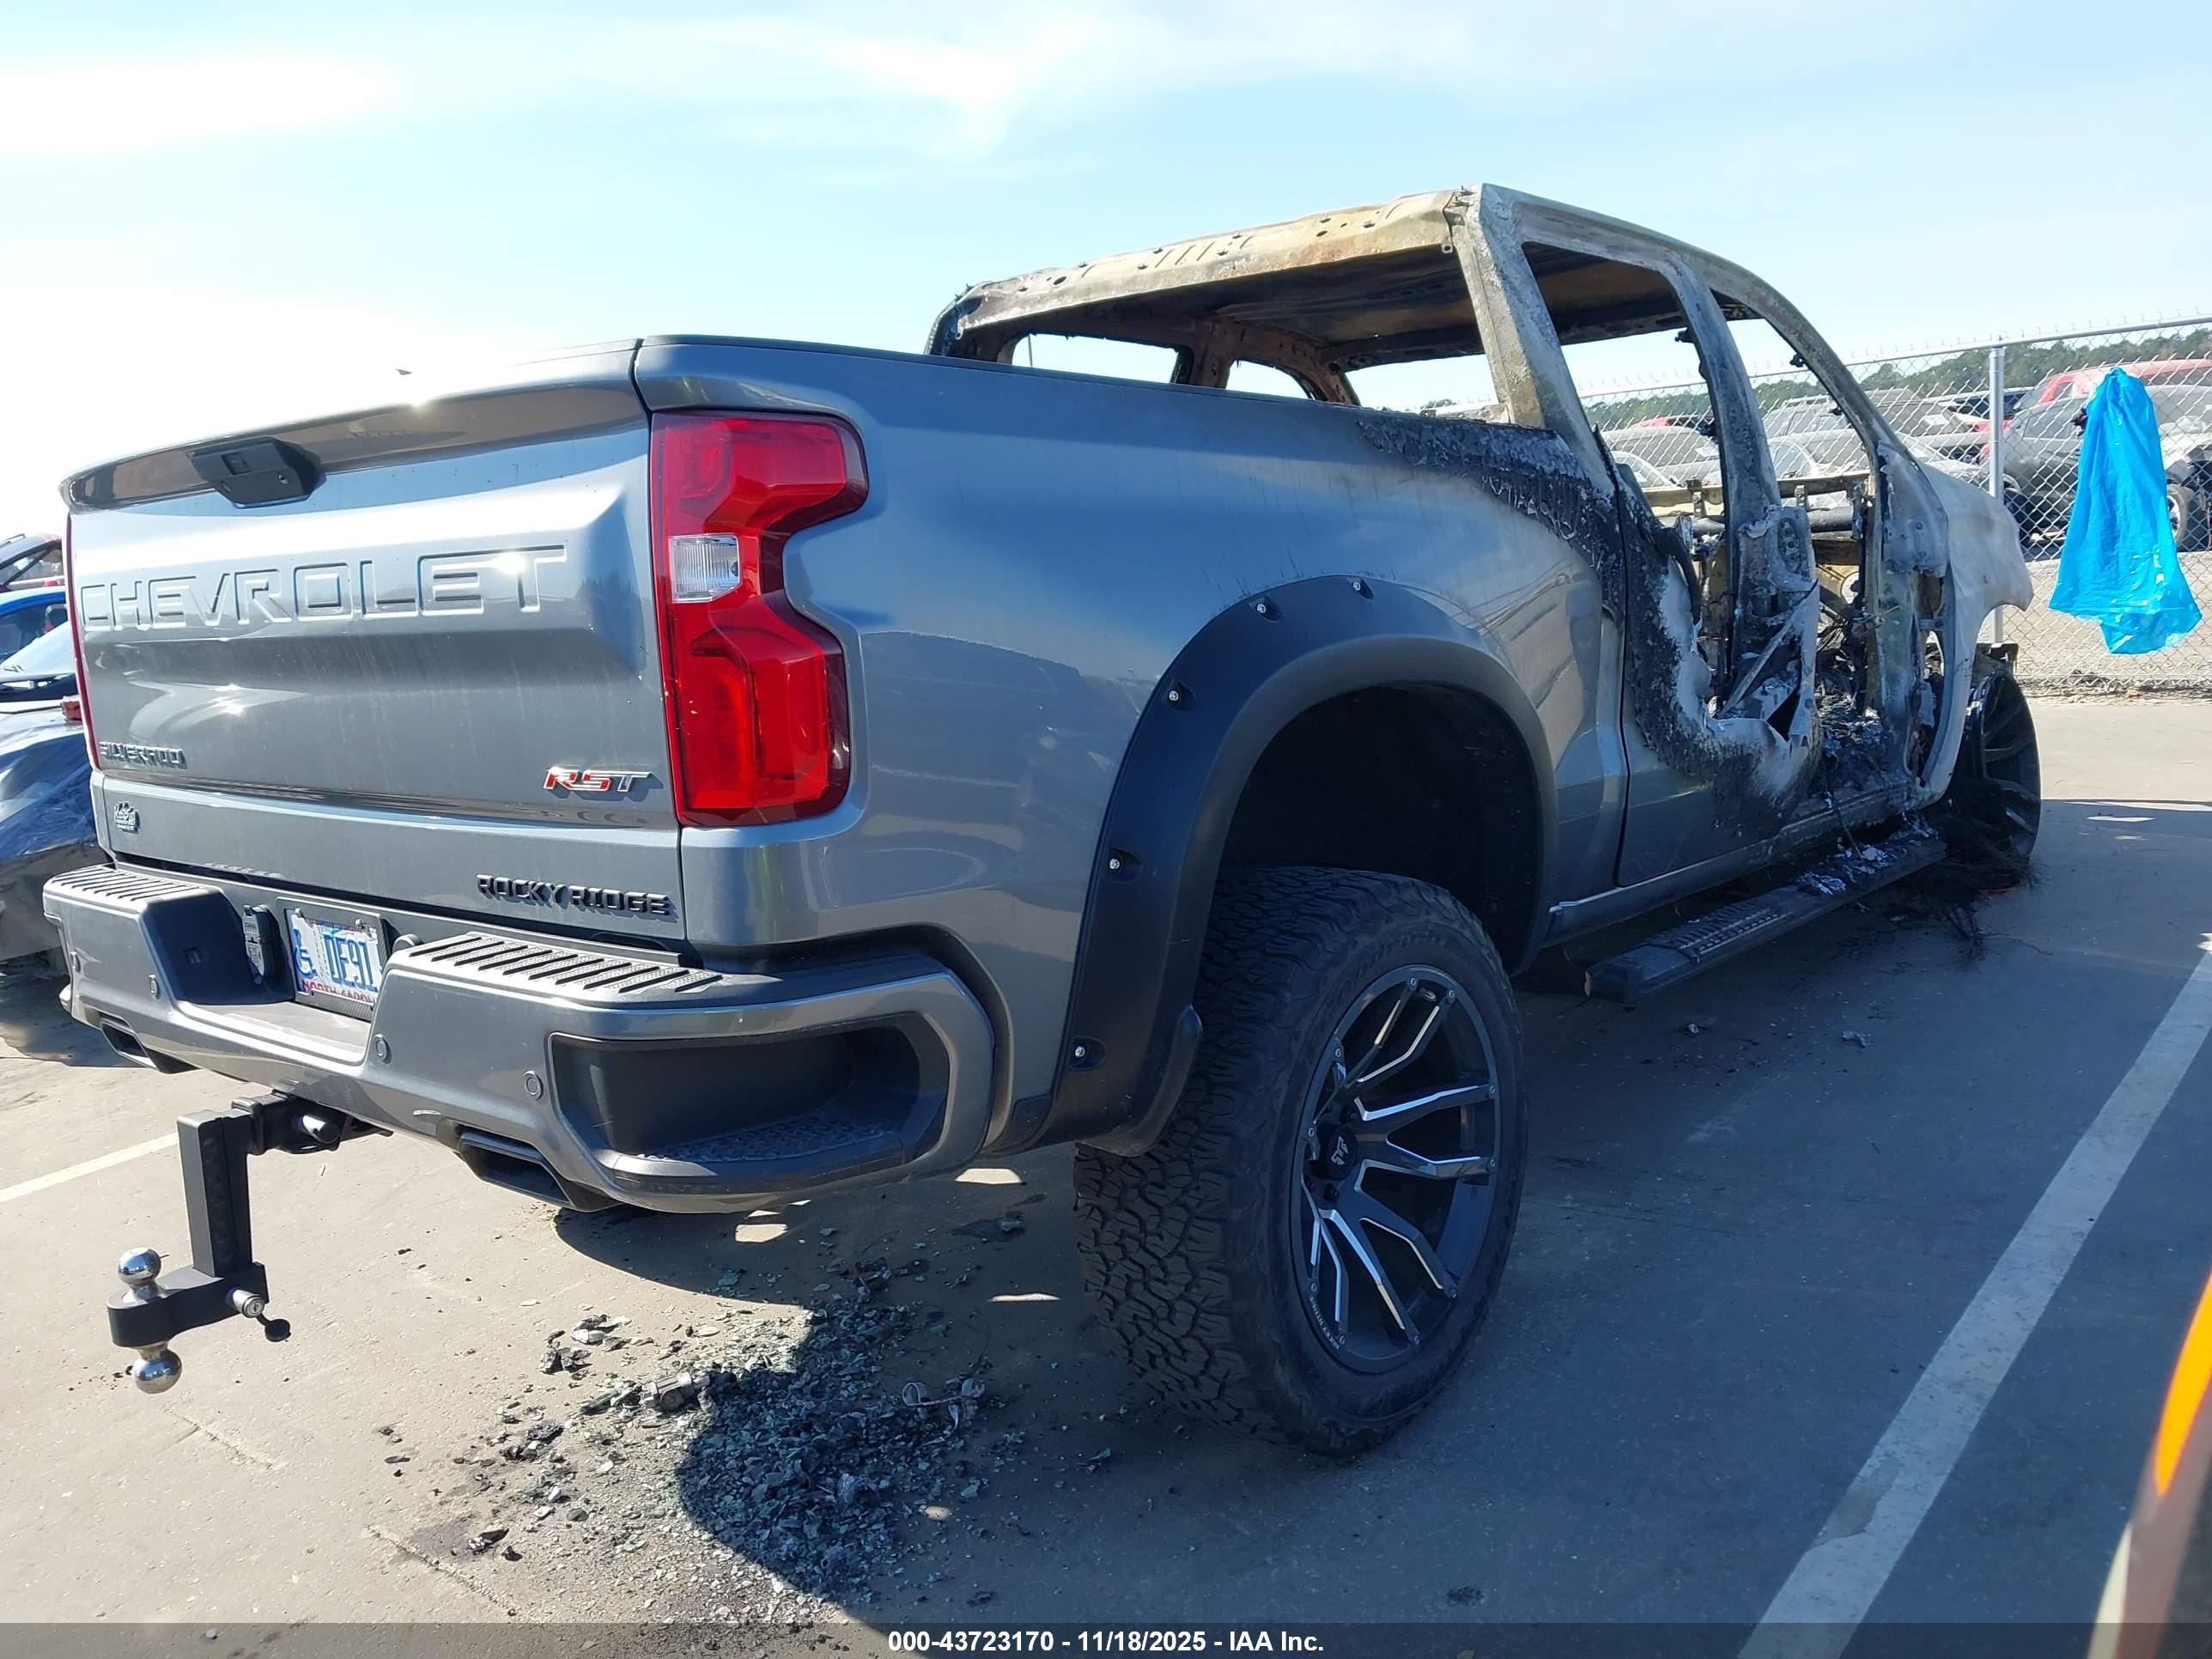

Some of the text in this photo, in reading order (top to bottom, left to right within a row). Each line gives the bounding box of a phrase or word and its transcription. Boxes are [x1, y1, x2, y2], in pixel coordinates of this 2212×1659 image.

[81, 544, 567, 632] CHEVROLET
[543, 766, 653, 793] RST
[476, 873, 671, 915] ROCKY RIDGE
